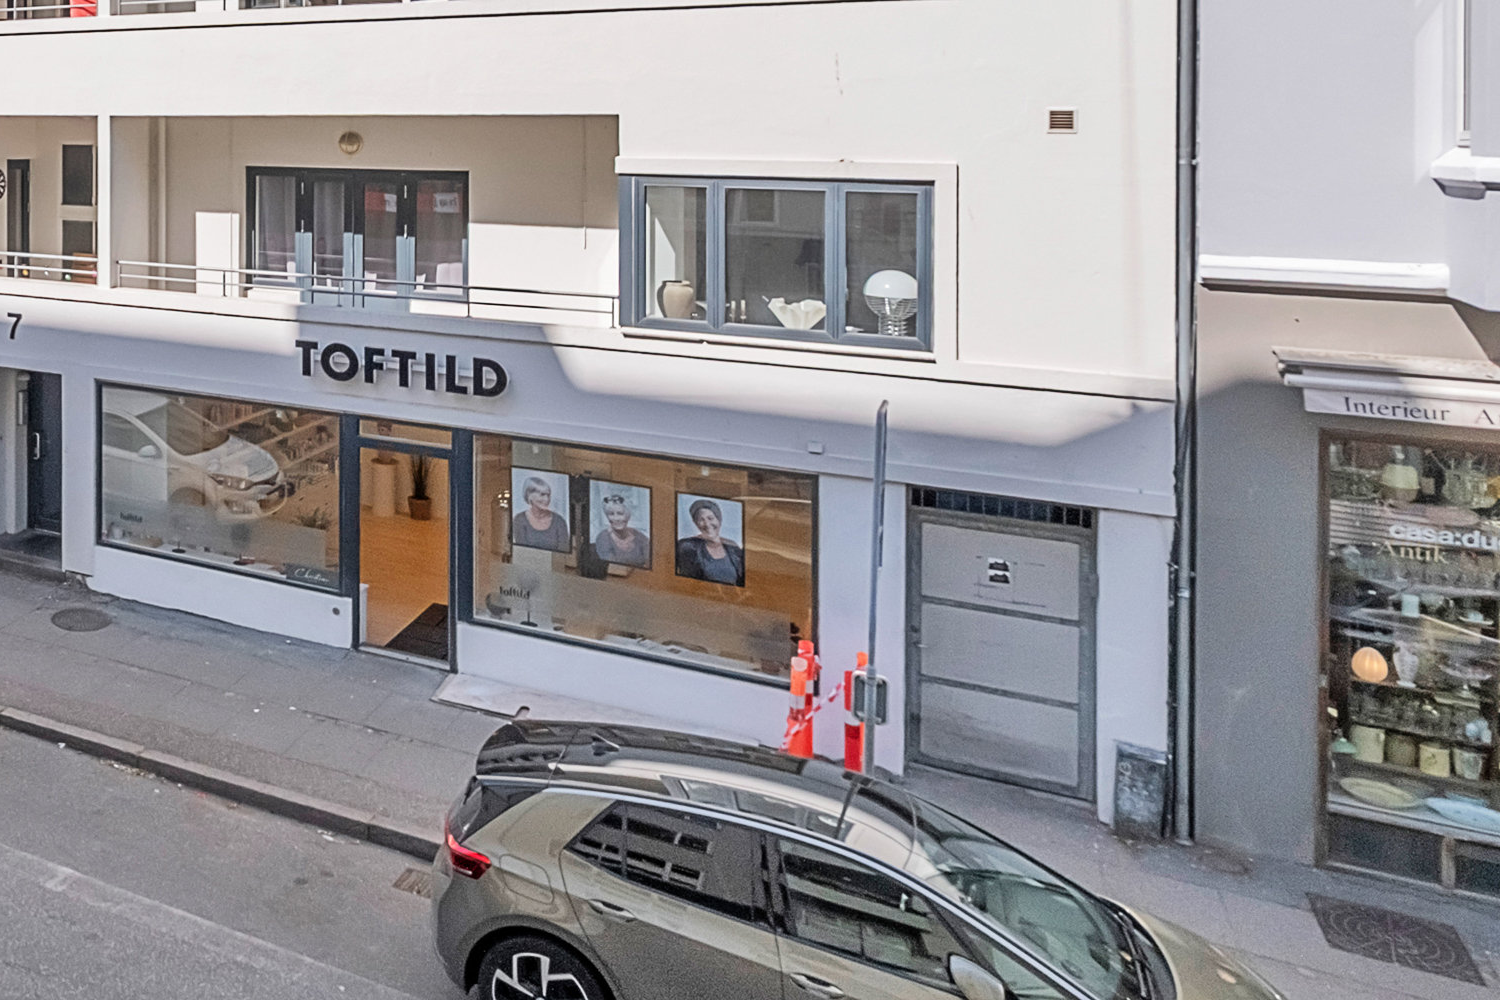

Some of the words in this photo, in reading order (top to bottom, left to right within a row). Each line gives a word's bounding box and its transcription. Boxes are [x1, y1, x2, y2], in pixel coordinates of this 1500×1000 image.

[7, 312, 22, 340] 7
[295, 340, 509, 398] TOFTILD
[1343, 396, 1451, 422] Interieur
[1475, 409, 1500, 425] A
[1377, 540, 1449, 564] Antik
